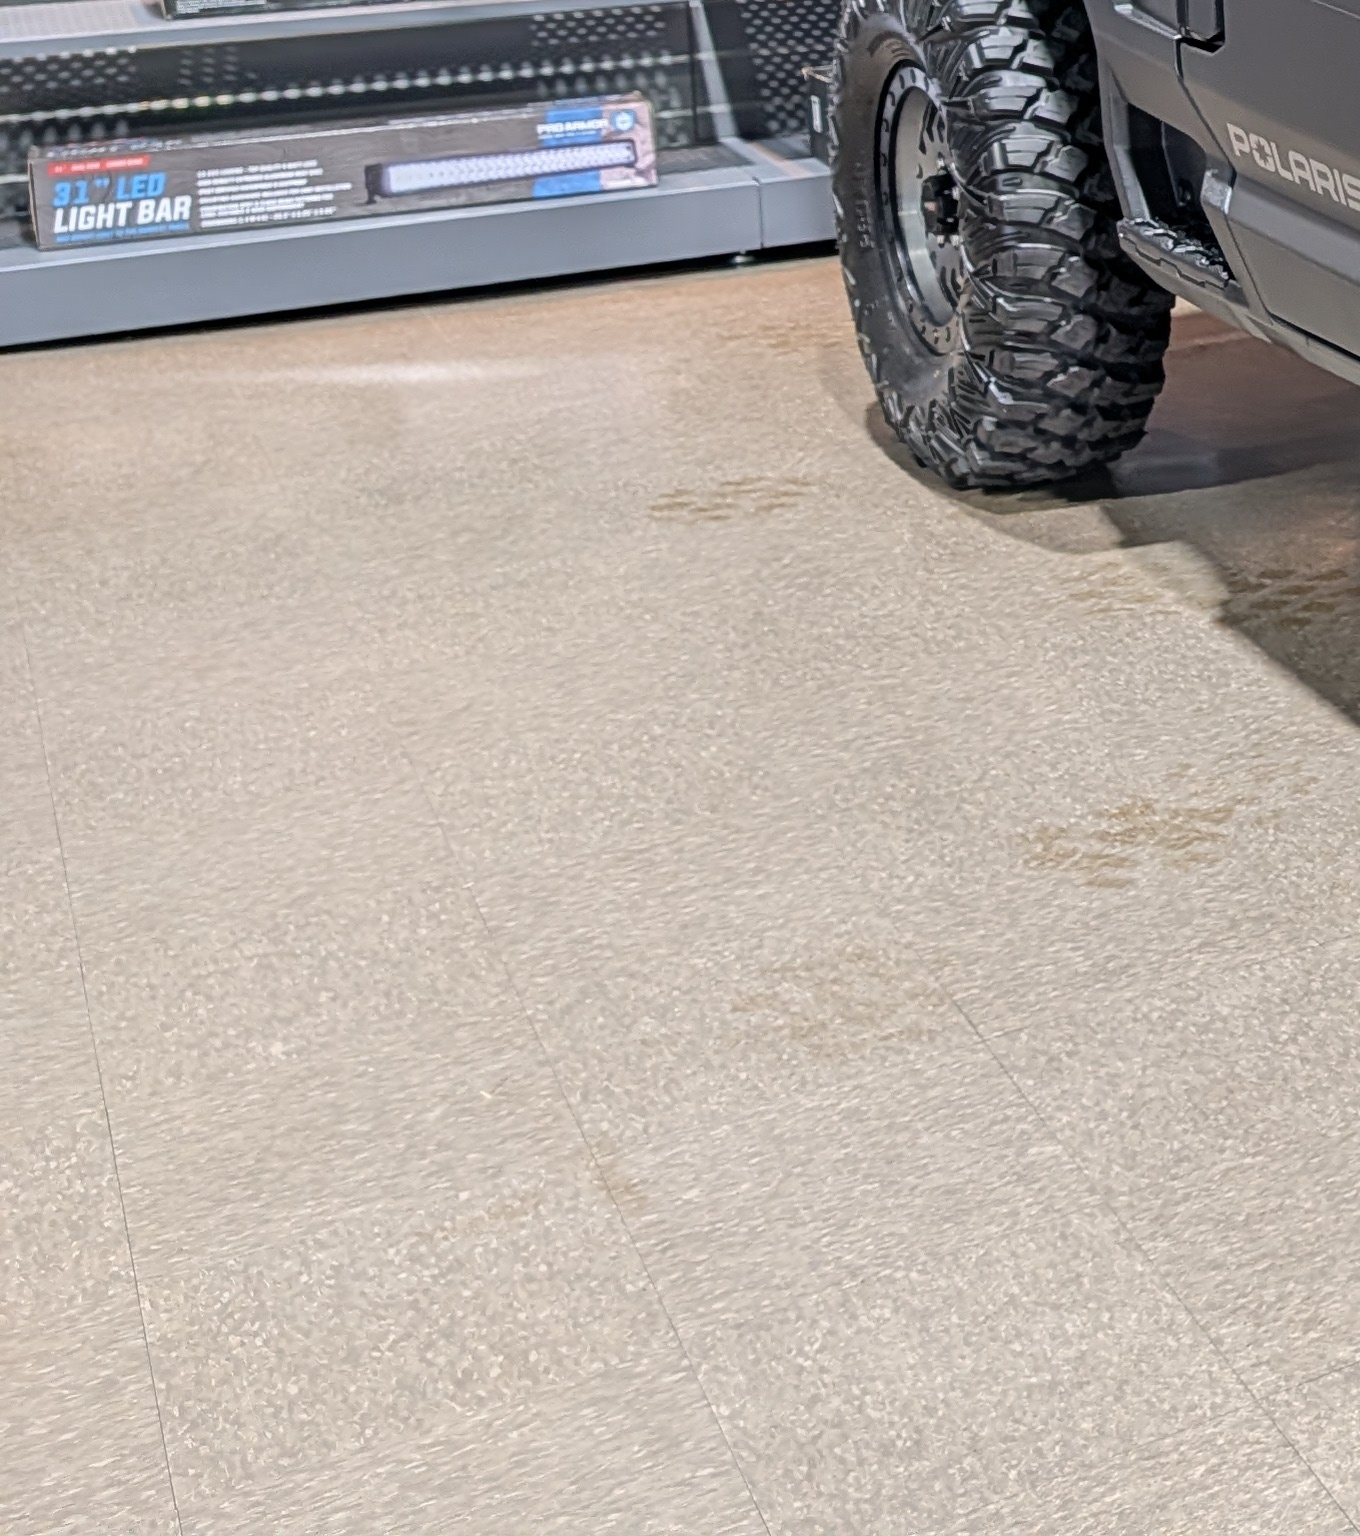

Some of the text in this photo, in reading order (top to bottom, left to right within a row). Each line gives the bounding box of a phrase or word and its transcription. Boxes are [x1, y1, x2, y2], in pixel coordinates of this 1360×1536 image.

[115, 172, 167, 200] LED
[54, 200, 133, 234] LIGHT
[136, 194, 192, 225] BAR
